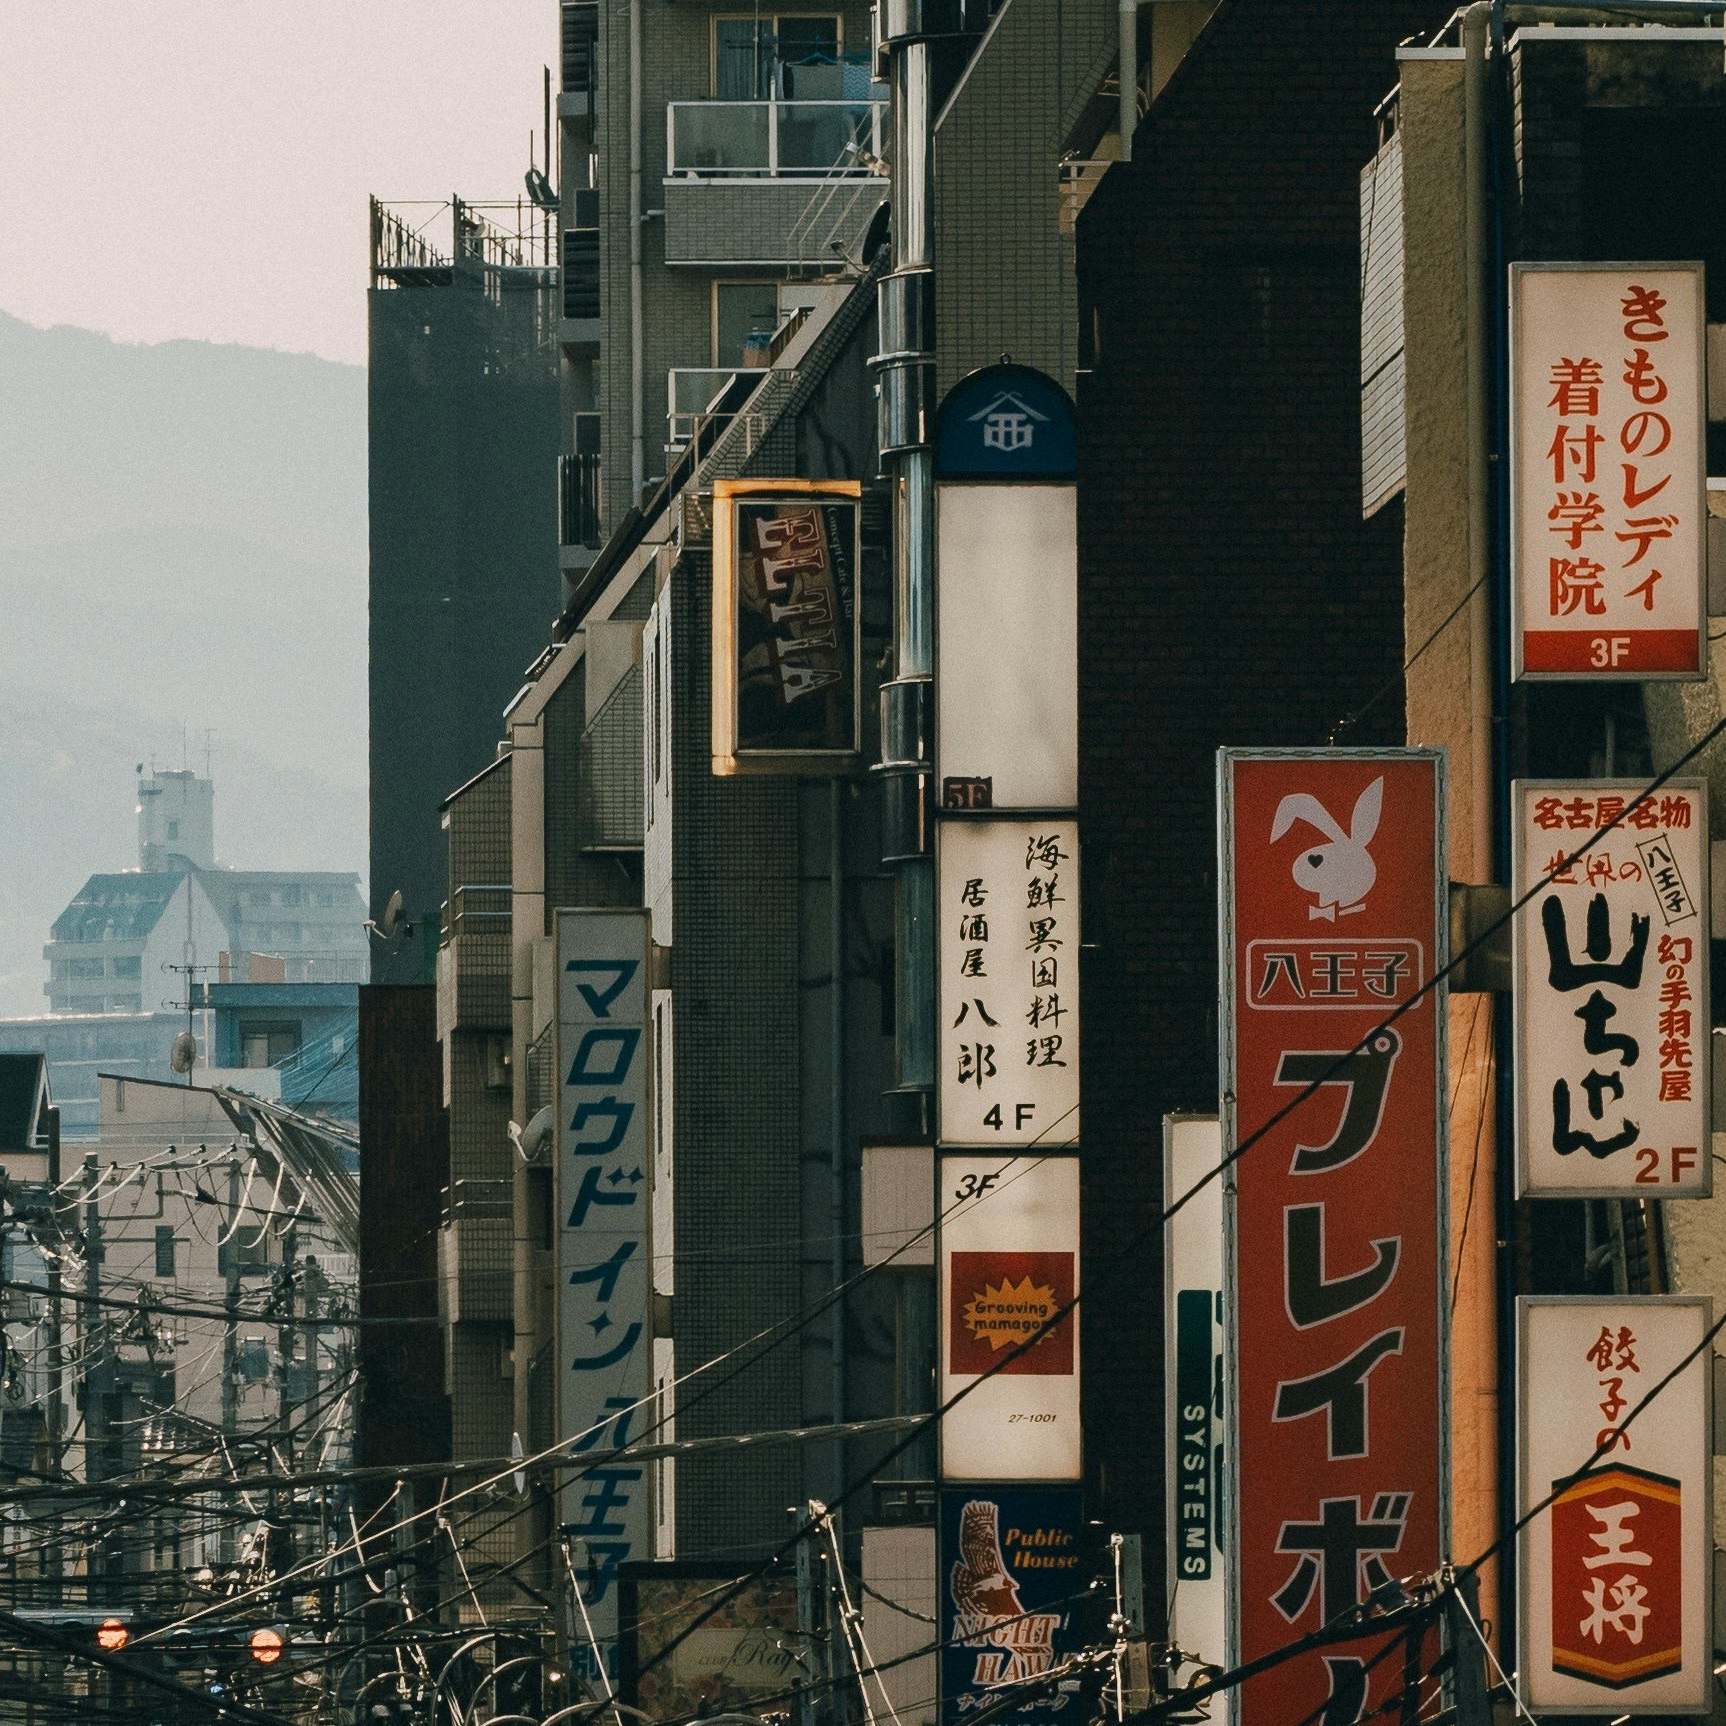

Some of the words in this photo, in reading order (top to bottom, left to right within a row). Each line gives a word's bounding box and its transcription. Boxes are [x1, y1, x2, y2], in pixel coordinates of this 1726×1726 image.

[1614, 285, 1679, 611] きものレディ
[1546, 357, 1608, 617] 着付学院
[1590, 637, 1631, 668] 3F
[1532, 796, 1692, 831] 名古屋名物
[1541, 849, 1642, 889] 世界の
[1645, 844, 1686, 915] 八王子
[1257, 951, 1411, 1000] 八王子
[1541, 892, 1651, 1159] 山ちゃん
[1657, 934, 1694, 1103] 幻の手羽先屋
[982, 1103, 1037, 1131] 4F
[1635, 1146, 1698, 1184] 2F
[955, 1173, 1000, 1200] 3F
[974, 1300, 1049, 1317] Grooving
[1585, 1325, 1641, 1456] 餃子の
[1008, 1413, 1057, 1424] 27-1001
[1182, 1403, 1208, 1577] SYSTEMS
[1005, 1527, 1074, 1548] Public
[1014, 1550, 1078, 1569] House
[1578, 1500, 1653, 1646] 王将
[949, 1612, 1061, 1648] NIGHT
[956, 1692, 1071, 1712] ナイーク
